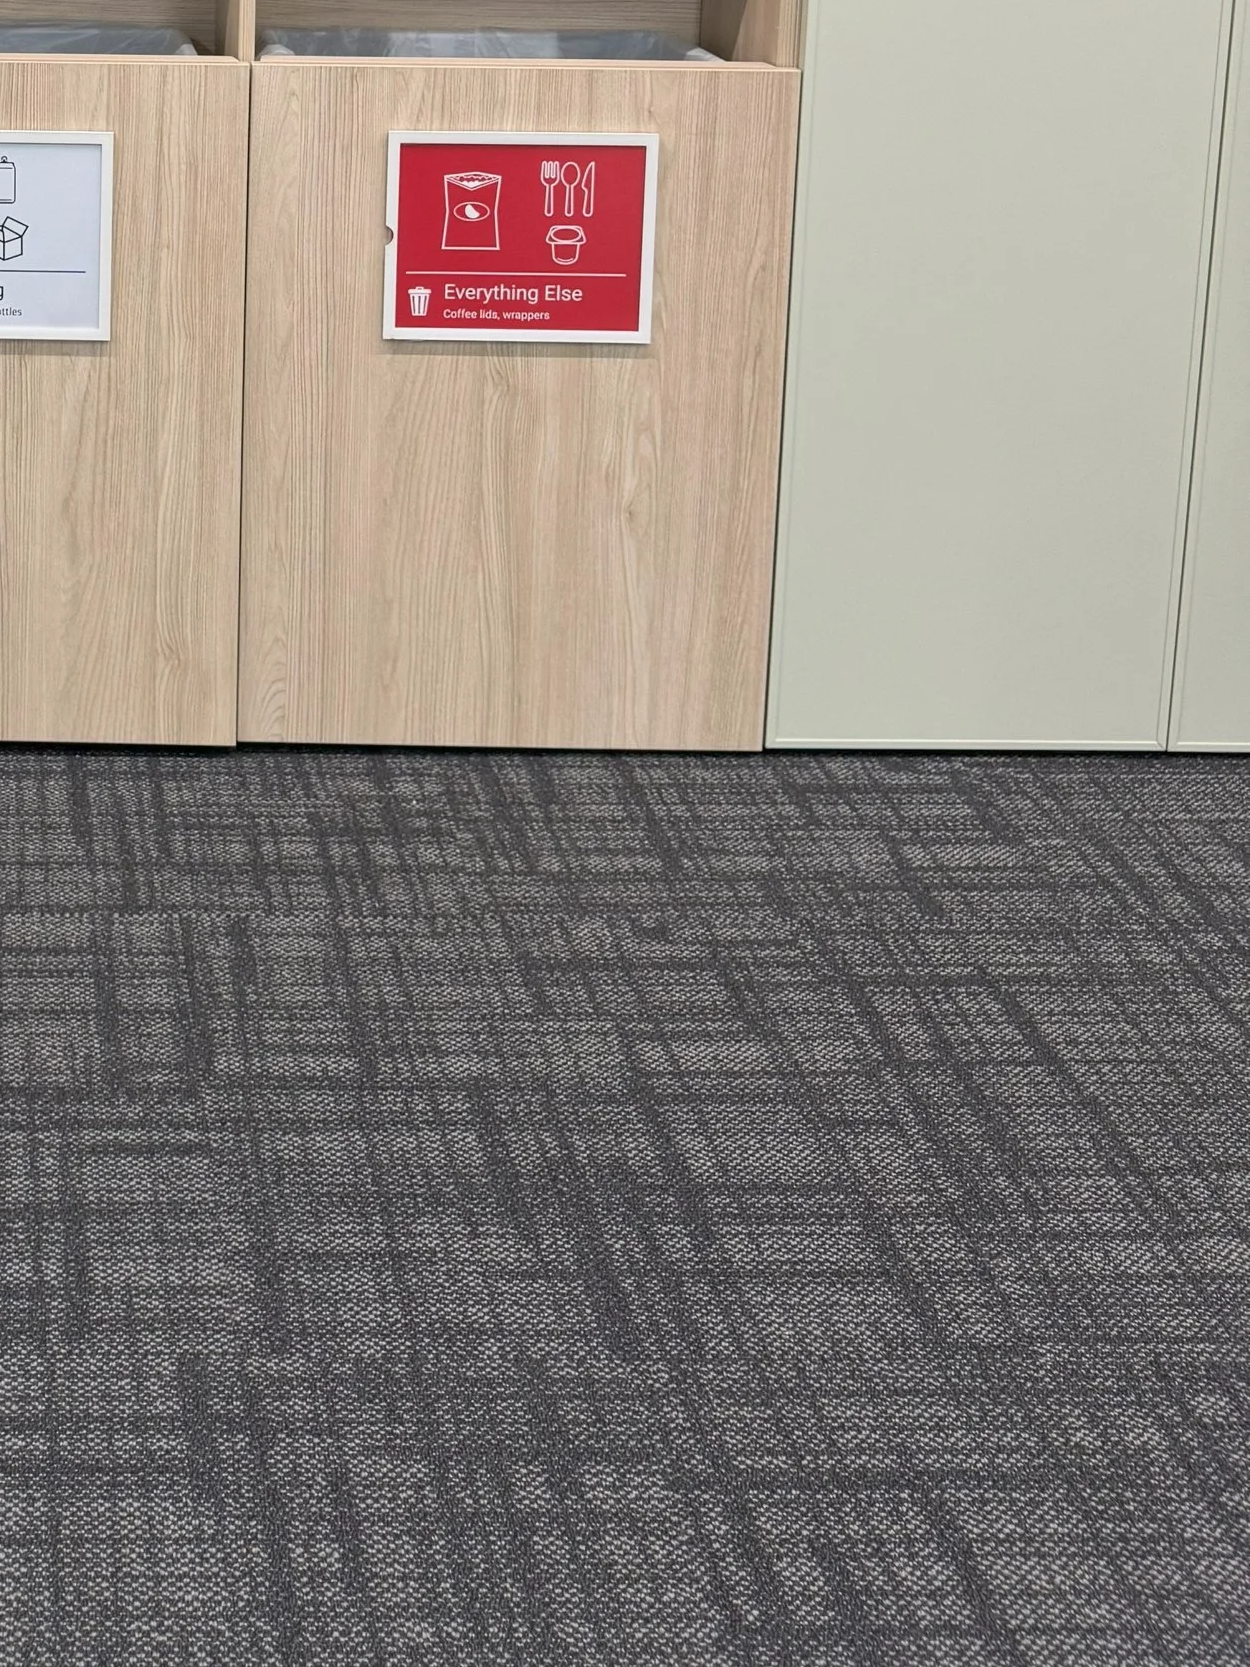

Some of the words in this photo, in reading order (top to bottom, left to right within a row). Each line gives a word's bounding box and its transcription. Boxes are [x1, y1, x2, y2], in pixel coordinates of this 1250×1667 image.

[444, 283, 539, 305] Everything
[544, 284, 583, 302] Else
[442, 308, 478, 319] Coffee
[479, 309, 501, 321] lids,
[502, 311, 551, 321] wrappers
